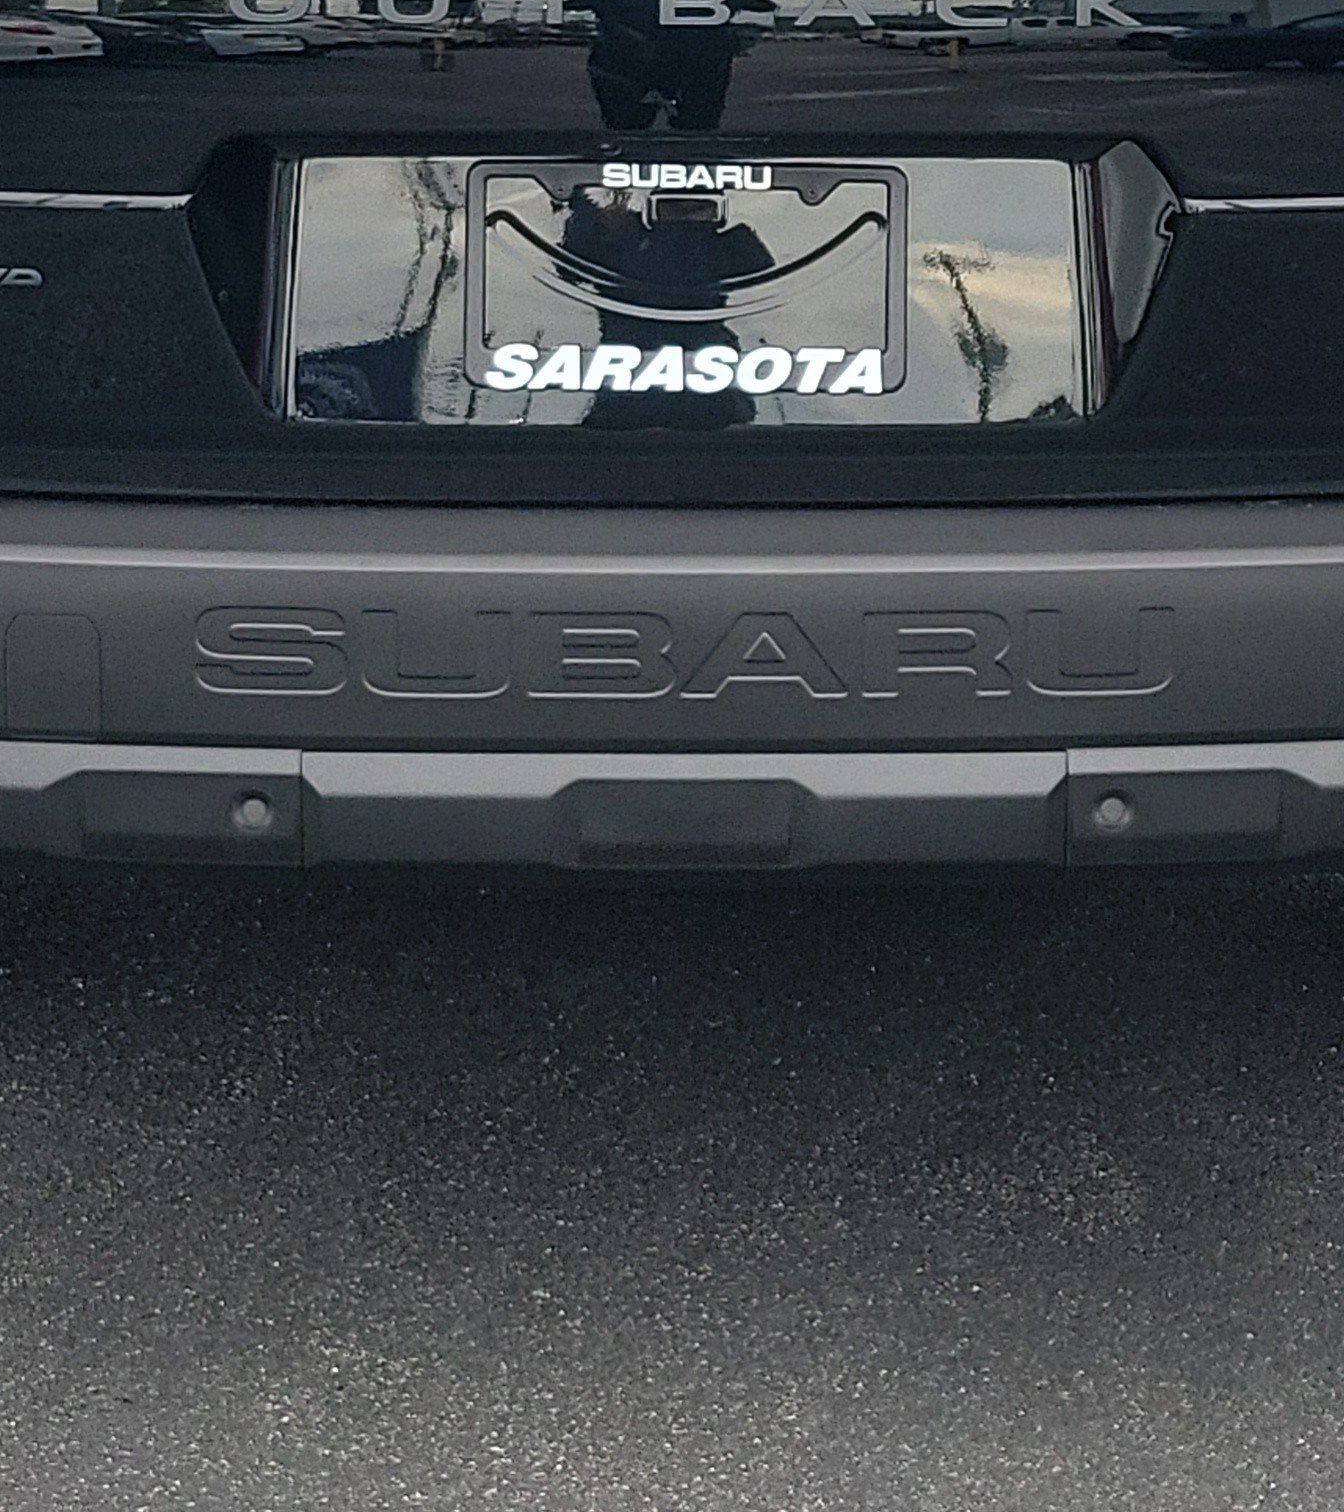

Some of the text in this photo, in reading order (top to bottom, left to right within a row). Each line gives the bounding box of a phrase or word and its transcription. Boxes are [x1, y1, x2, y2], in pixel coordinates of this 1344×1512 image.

[602, 163, 772, 191] SUBARU
[485, 344, 884, 395] SARASOTA
[195, 604, 1176, 699] SUBARU
